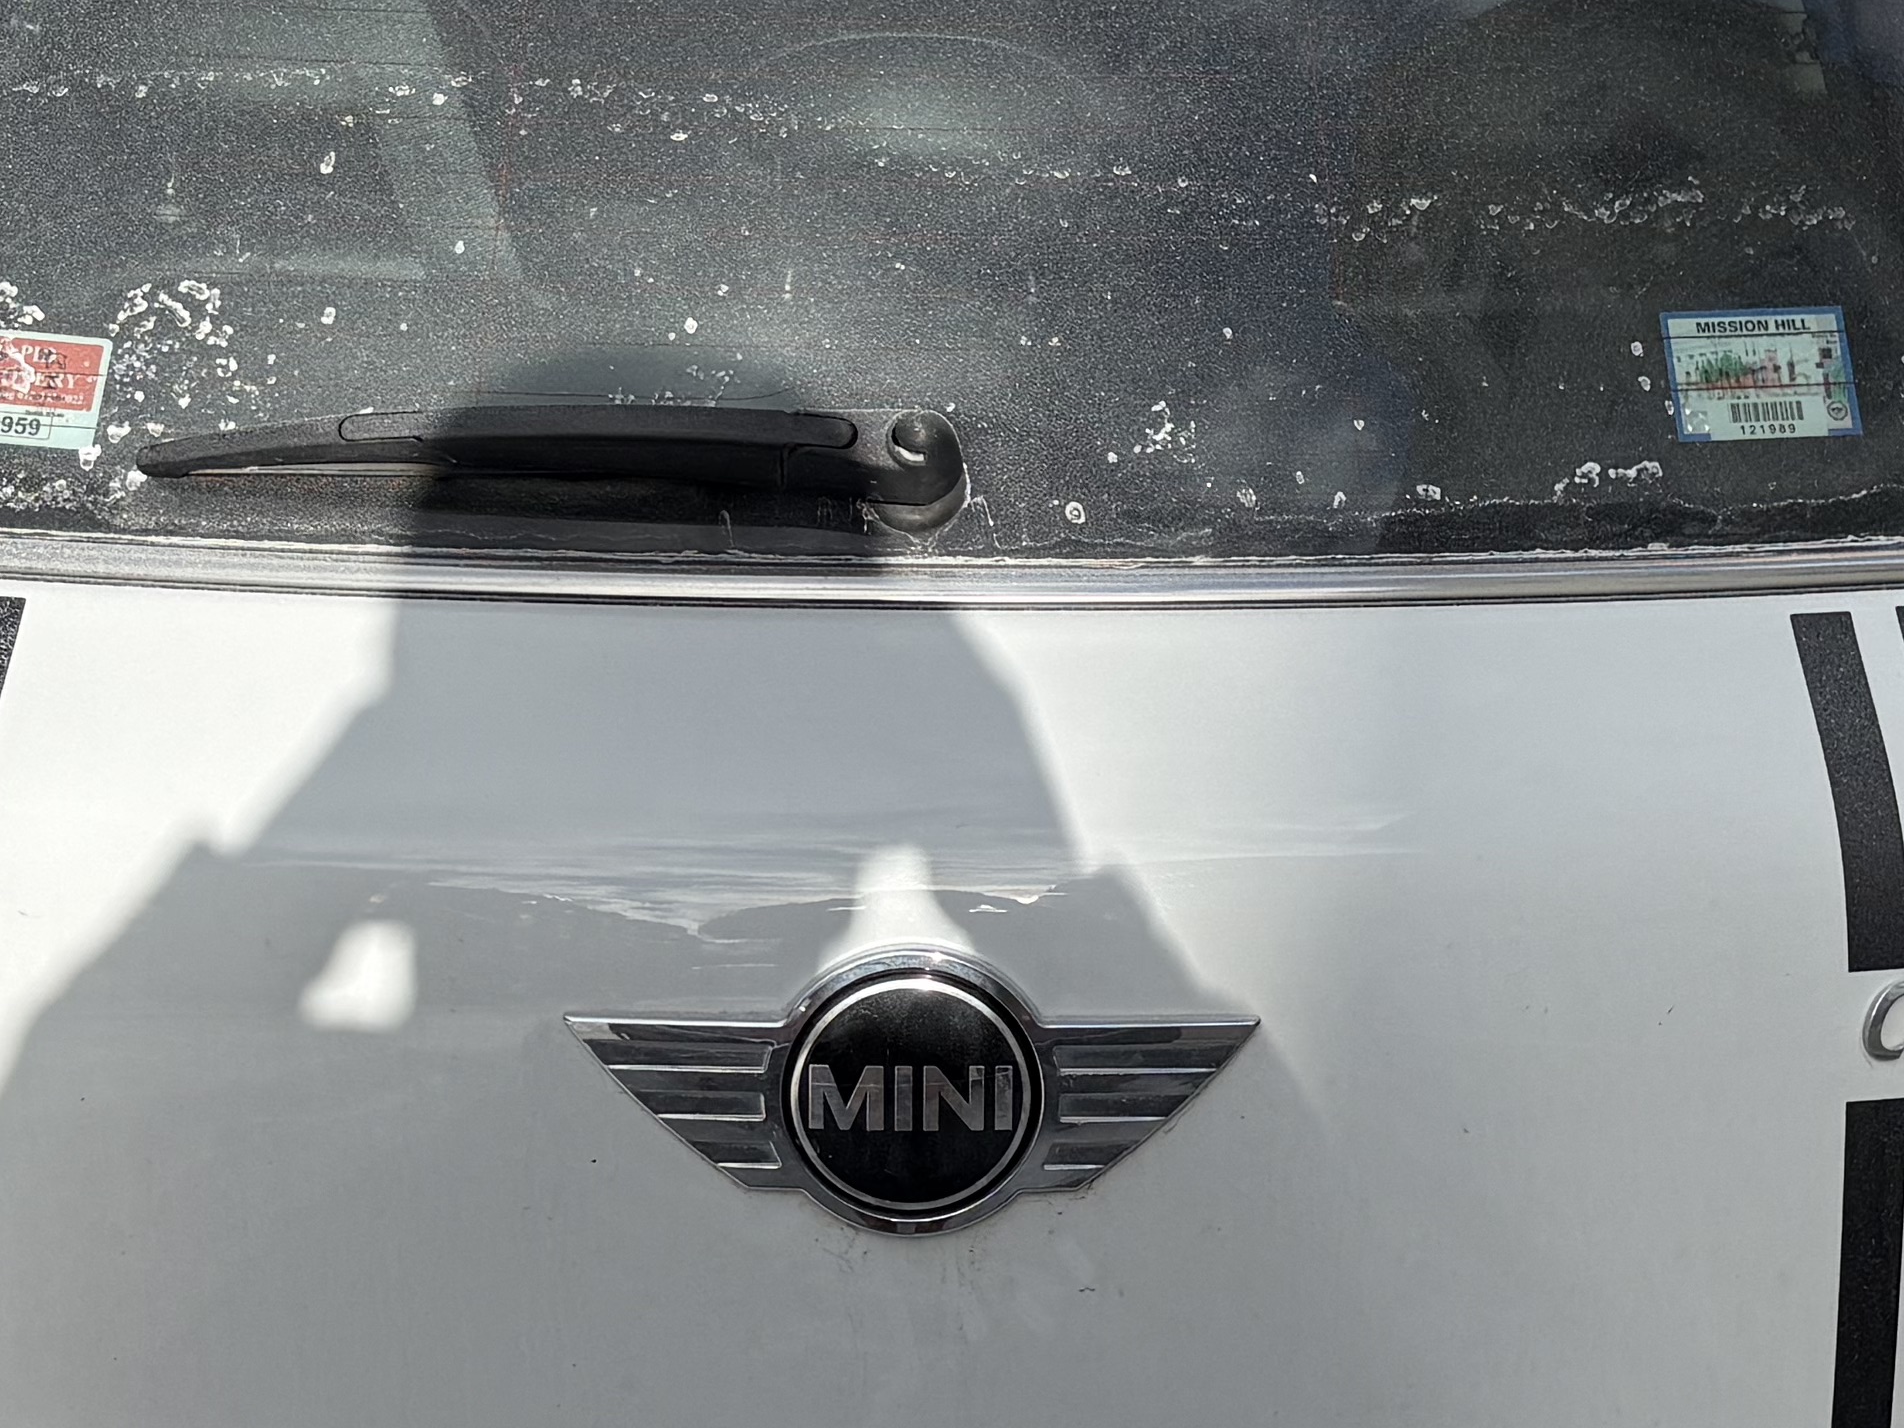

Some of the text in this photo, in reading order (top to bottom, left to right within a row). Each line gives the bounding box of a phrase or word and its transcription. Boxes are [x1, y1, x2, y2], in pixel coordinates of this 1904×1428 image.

[1696, 318, 1811, 334] MISSION HILL
[807, 1064, 1014, 1132] MINI
